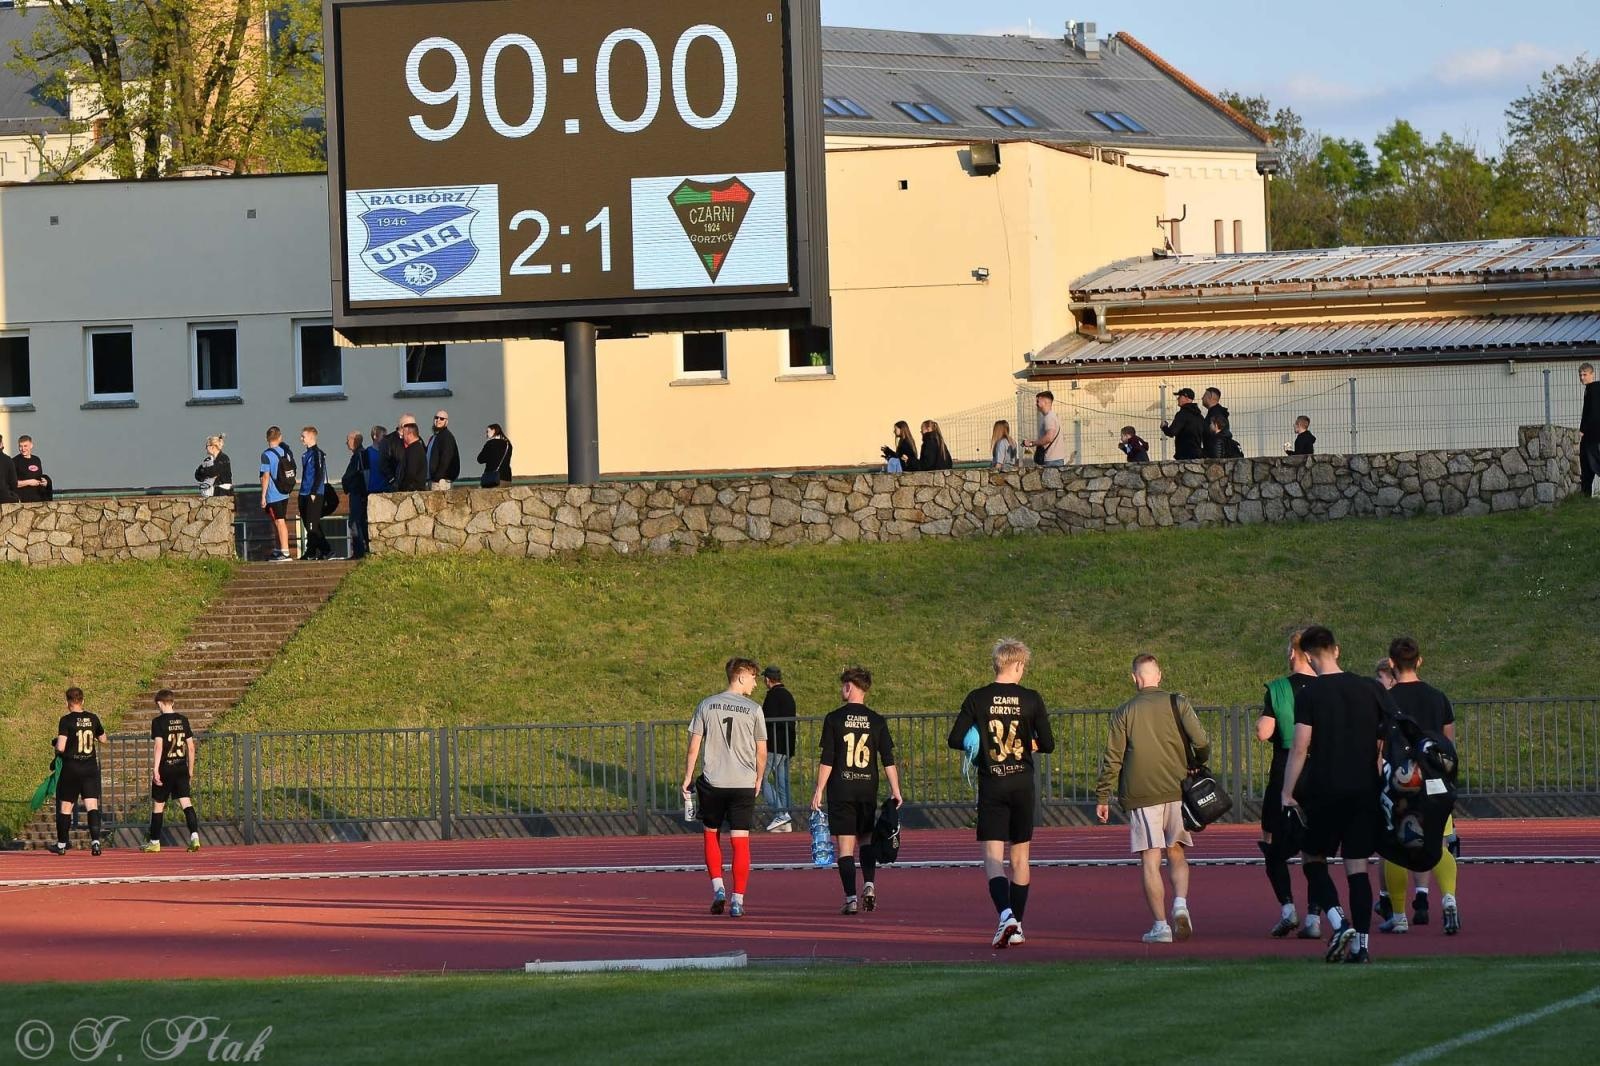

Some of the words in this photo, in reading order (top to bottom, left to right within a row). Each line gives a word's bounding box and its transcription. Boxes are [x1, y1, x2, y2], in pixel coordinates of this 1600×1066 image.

[405, 23, 738, 142] 90:00
[370, 190, 466, 205] RACIBÓRZ
[378, 217, 407, 228] 1946
[689, 205, 735, 225] CZARNI
[690, 232, 734, 244] GORZYCE
[703, 223, 720, 232] 1924
[371, 215, 463, 265] UNIA
[508, 206, 612, 276] 2:1
[990, 706, 1021, 715] GORZYCE
[993, 696, 1019, 705] CZARNI
[76, 729, 94, 754] 10
[722, 716, 733, 748] 1
[989, 719, 1024, 762] 34
[167, 733, 186, 757] 25
[843, 732, 870, 768] 16
[1197, 792, 1216, 806] SELECT
